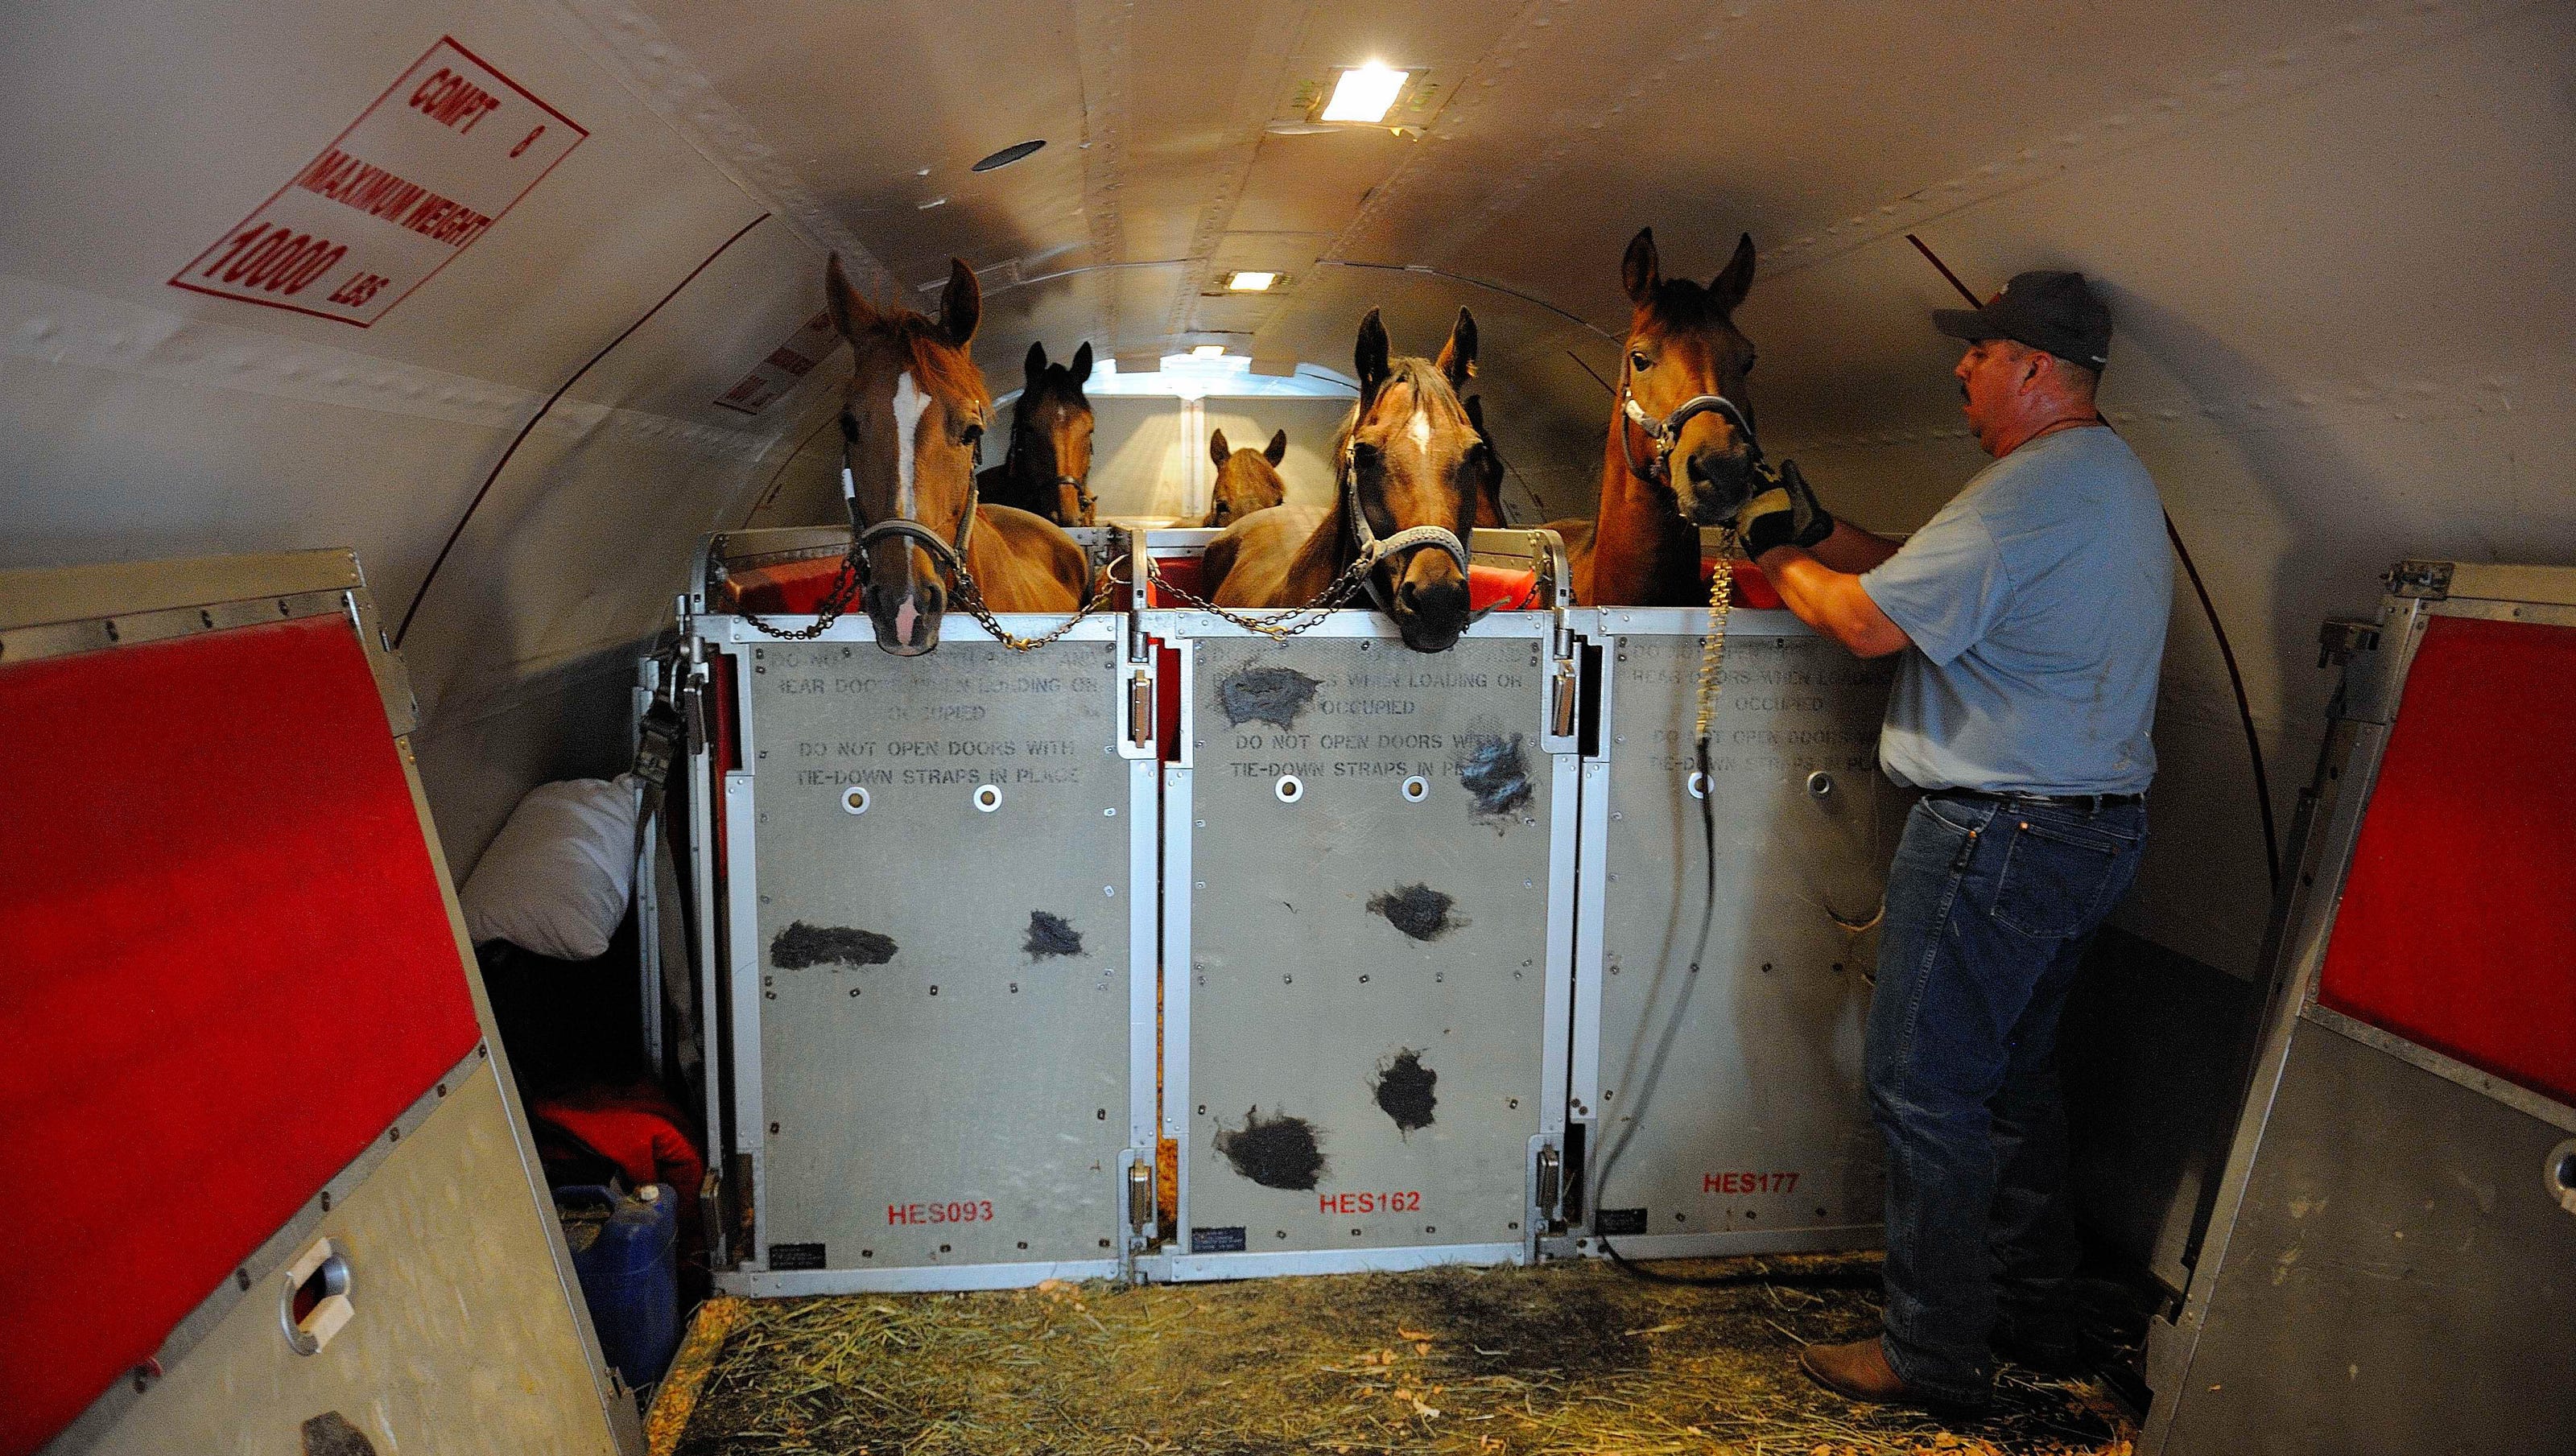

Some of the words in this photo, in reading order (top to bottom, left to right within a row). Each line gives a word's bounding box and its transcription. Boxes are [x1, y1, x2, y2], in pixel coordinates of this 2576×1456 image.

[408, 68, 500, 134] COMPT
[299, 149, 427, 224] MAXIMUM
[401, 193, 492, 247] WEIGHT
[203, 223, 348, 295] 10000
[328, 272, 390, 307] LBS
[1348, 674, 1402, 687] WHN
[1408, 673, 1488, 688] LOADING
[1496, 673, 1522, 688] OR
[1320, 699, 1415, 716] OCCUPIED
[799, 741, 828, 757] DO
[837, 741, 877, 757] NOT
[887, 741, 939, 757] OPEN
[947, 740, 1017, 757] DOORS
[1025, 740, 1075, 756] WITH
[1235, 734, 1263, 750] DO
[1272, 734, 1311, 750] NOT
[1319, 734, 1369, 750] OPEN
[1377, 734, 1443, 749] DOORS
[796, 769, 893, 786] TIE-DOWN
[902, 768, 980, 785] STRAPS
[989, 768, 1008, 784] IN
[1231, 761, 1325, 778] TIE-DOWN
[1333, 761, 1408, 777] STRAPS
[1417, 761, 1434, 777] IN
[1703, 1172, 1799, 1194] HES177
[1319, 1190, 1421, 1214] HES162
[888, 1200, 994, 1225] HES093
